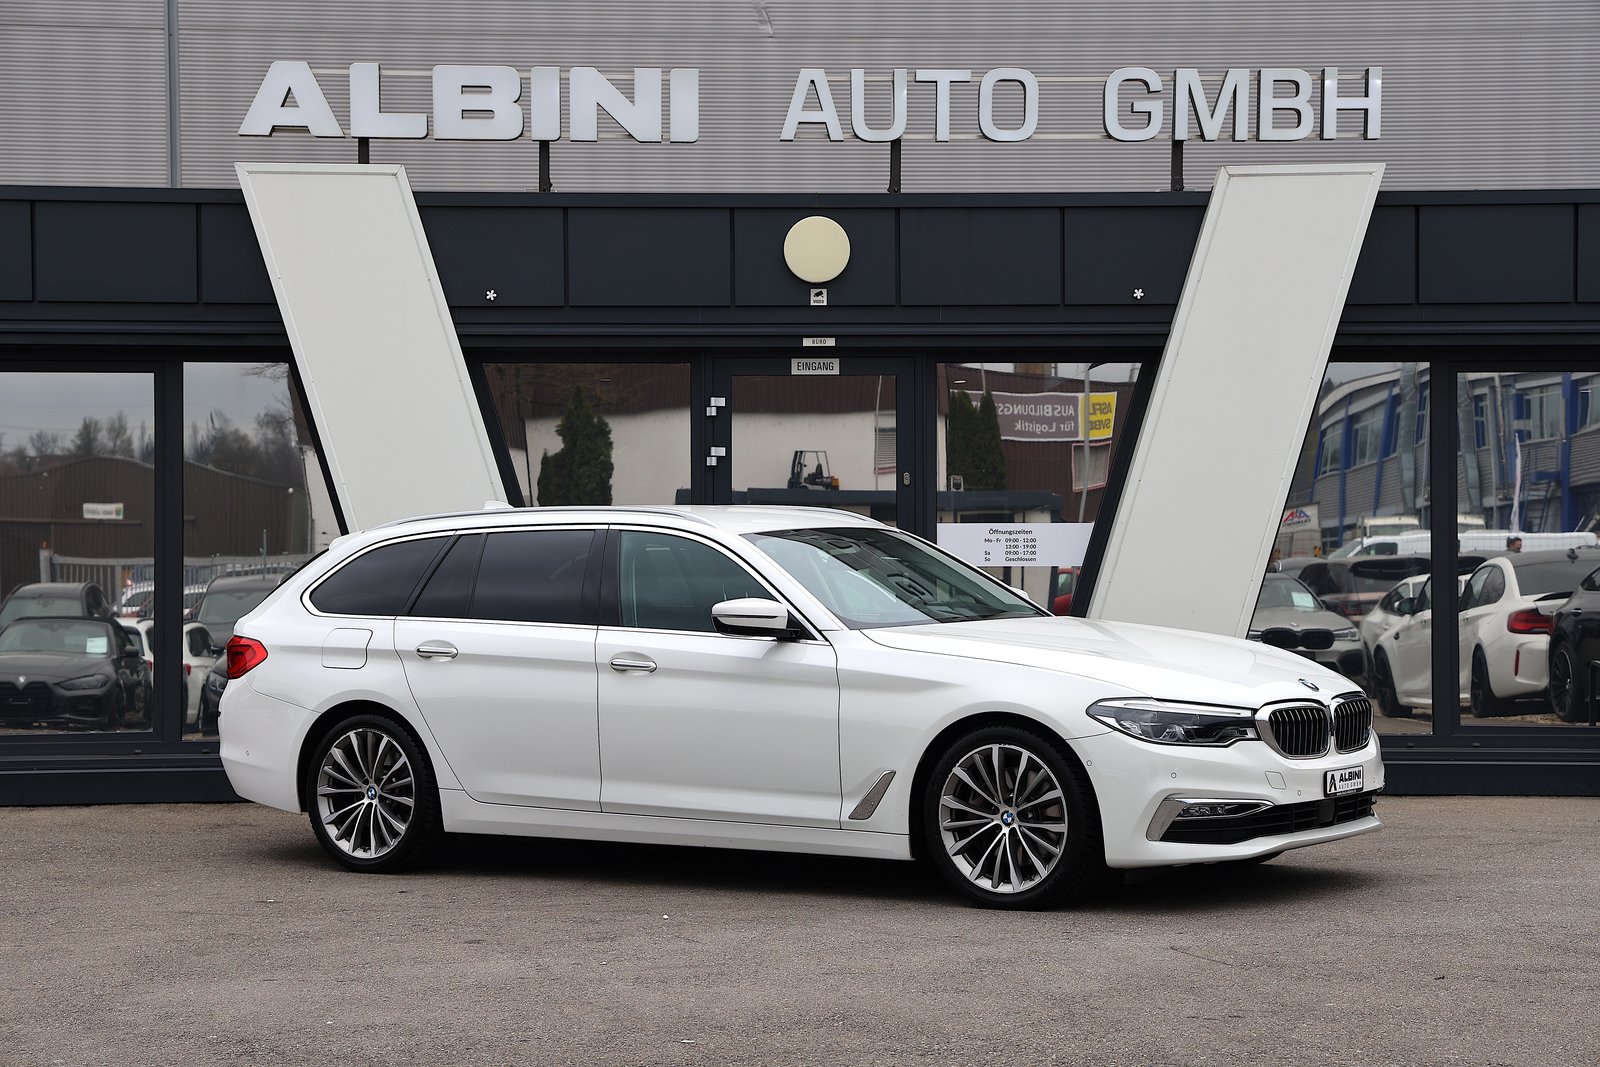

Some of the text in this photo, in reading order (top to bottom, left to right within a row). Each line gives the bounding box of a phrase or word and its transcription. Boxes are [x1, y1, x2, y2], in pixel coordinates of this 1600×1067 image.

[238, 60, 1383, 143] ALBINI AUTO GMBH
[797, 361, 834, 371] EINGANG
[988, 528, 1033, 536] Öffnungszeiten
[1339, 770, 1361, 783] ALBINI
